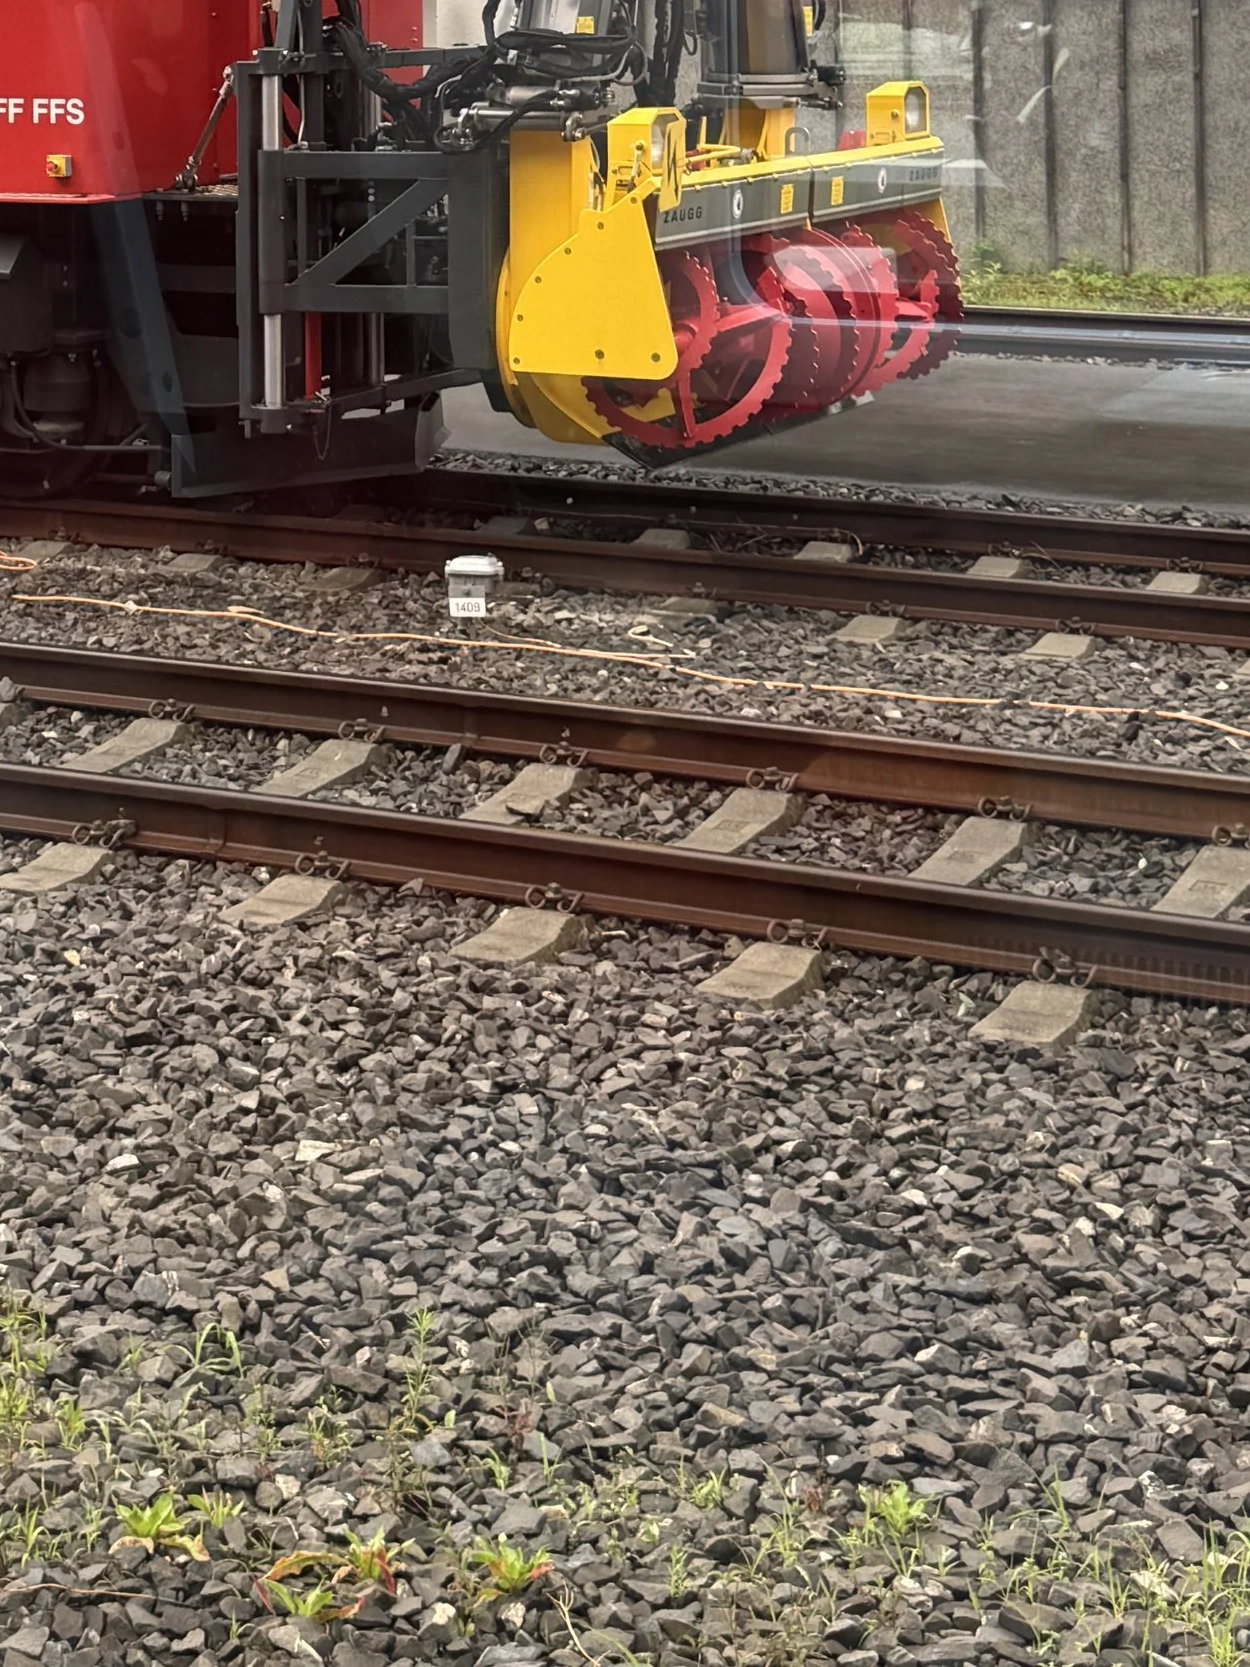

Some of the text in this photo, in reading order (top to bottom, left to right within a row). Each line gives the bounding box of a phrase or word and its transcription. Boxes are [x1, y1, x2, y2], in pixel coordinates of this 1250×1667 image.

[32, 98, 85, 125] FFS
[663, 206, 703, 223] ZAUGG
[455, 602, 481, 613] 1409
